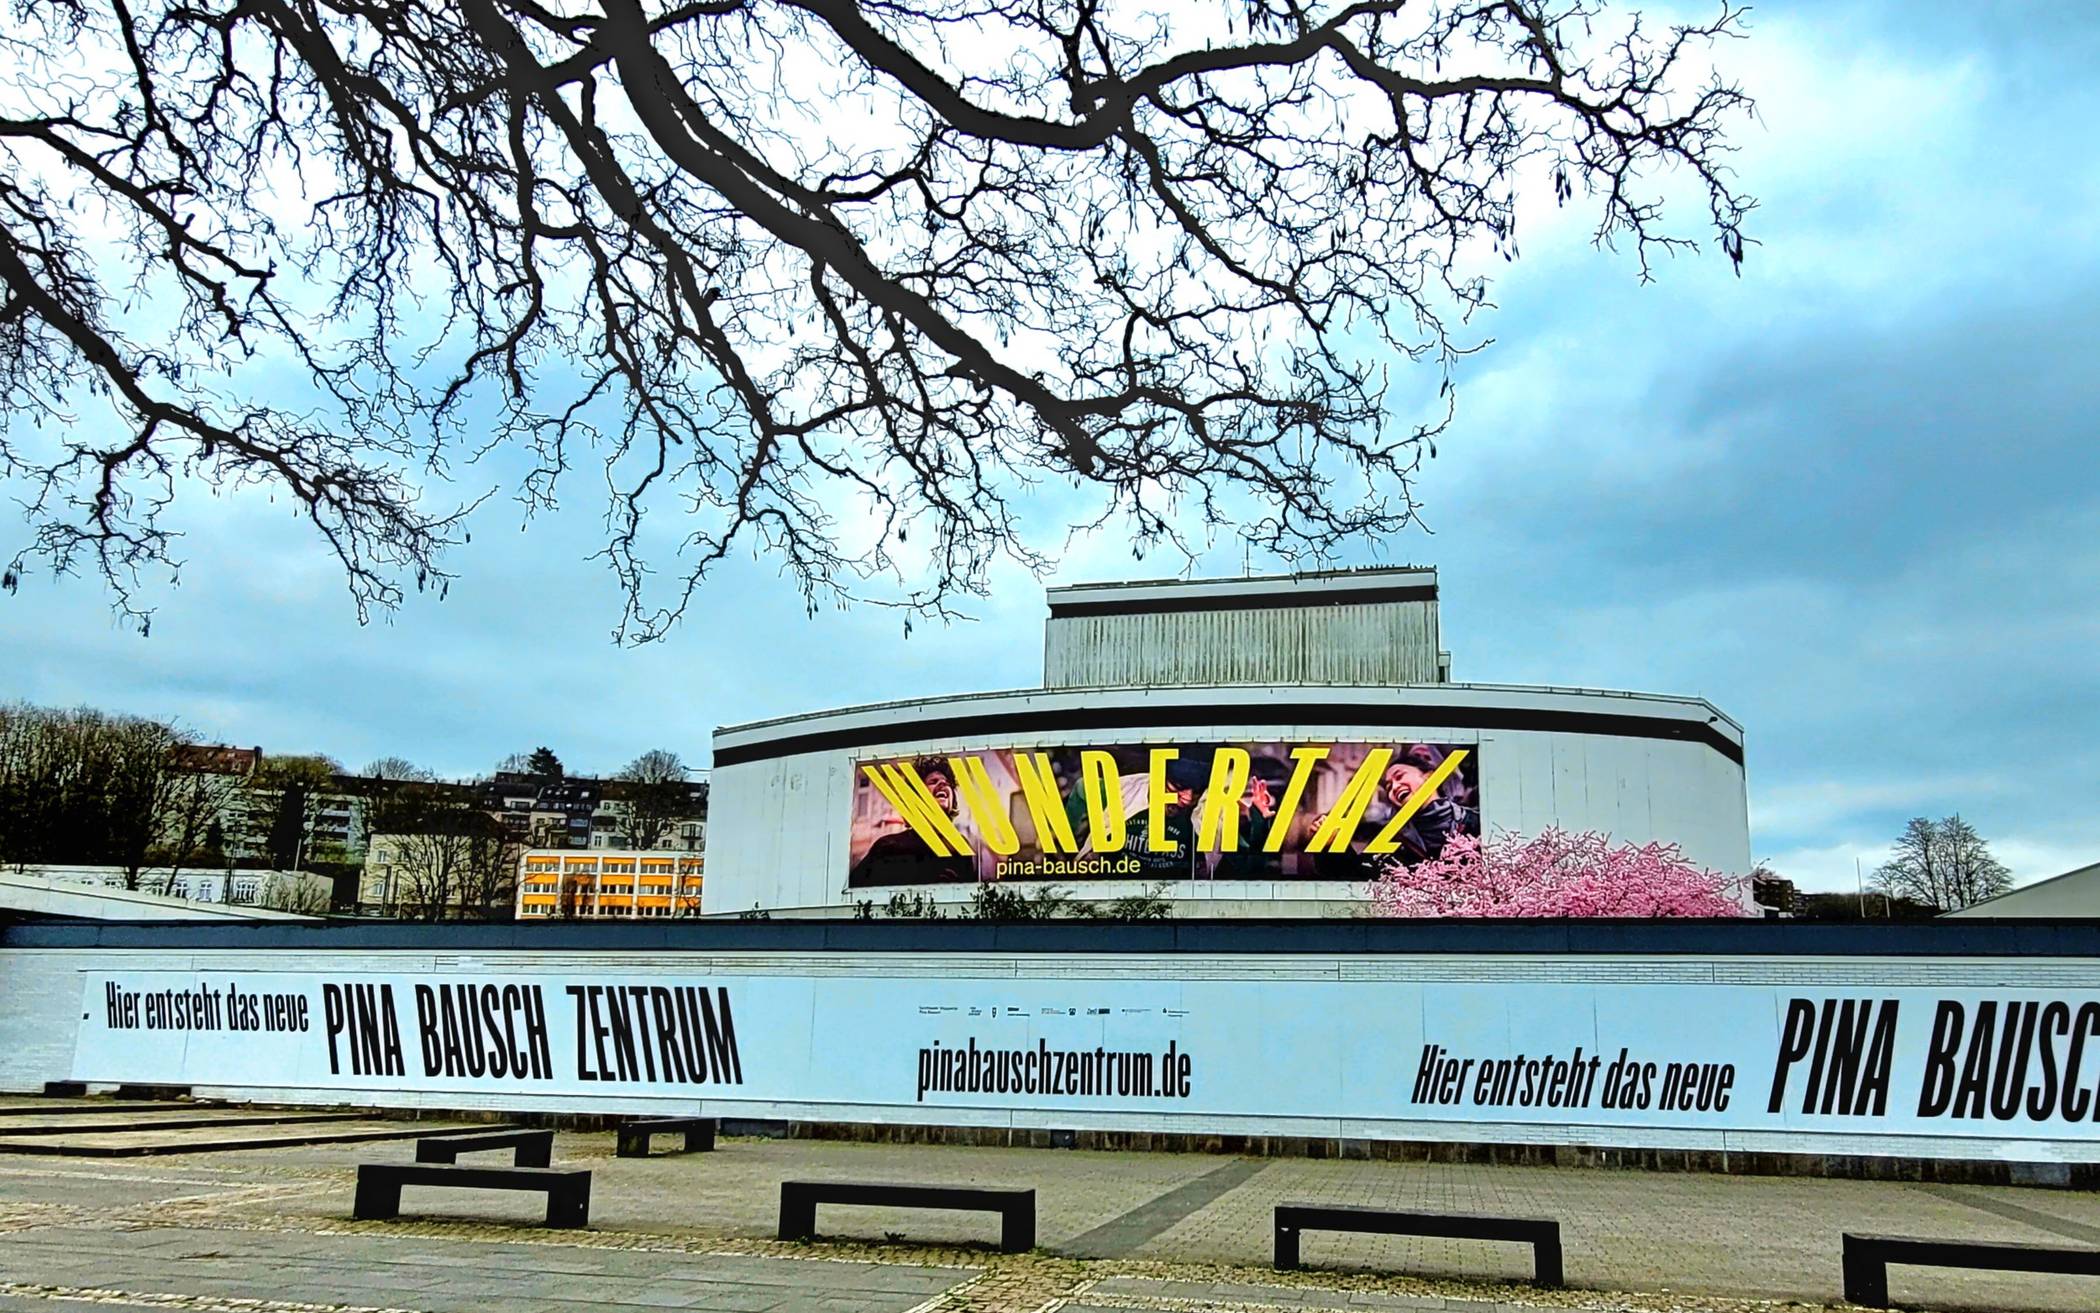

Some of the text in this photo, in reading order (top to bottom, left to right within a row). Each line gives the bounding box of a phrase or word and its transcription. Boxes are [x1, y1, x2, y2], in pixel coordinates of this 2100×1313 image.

[860, 747, 1469, 858] WUNDERTAL
[996, 855, 1141, 879] pina-bausch.de
[105, 981, 744, 1085] Hier entsteht das neue PINA BAUSCH ZENTRUM
[917, 1036, 1192, 1102] pinabauschzentrum.de
[1410, 998, 2100, 1123] Hier entsteht das neue PINA BAUSC
